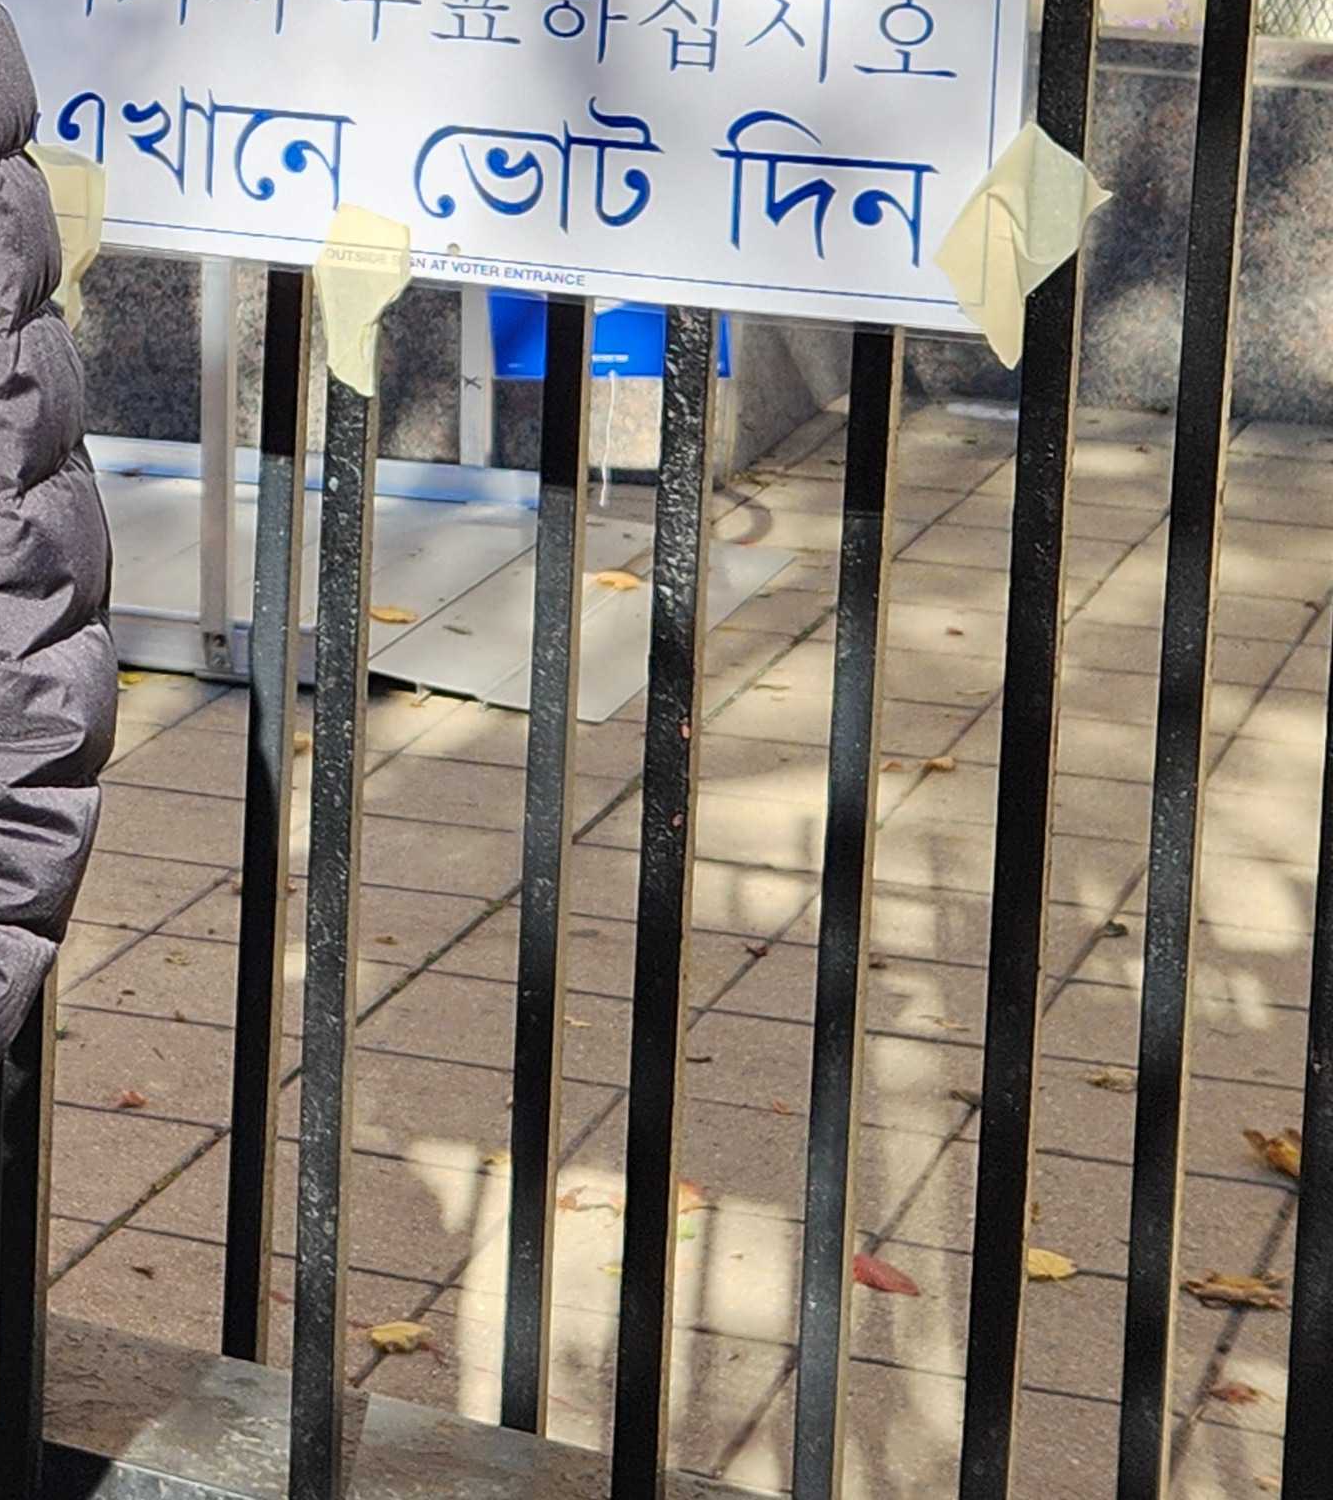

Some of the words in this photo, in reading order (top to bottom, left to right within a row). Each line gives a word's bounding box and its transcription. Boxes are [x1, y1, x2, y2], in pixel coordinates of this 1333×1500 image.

[413, 96, 663, 234] ভোট
[712, 110, 940, 267] দিন
[430, 260, 447, 272] AT
[451, 261, 500, 278] VOTER
[504, 266, 586, 287] ENTRANCE
